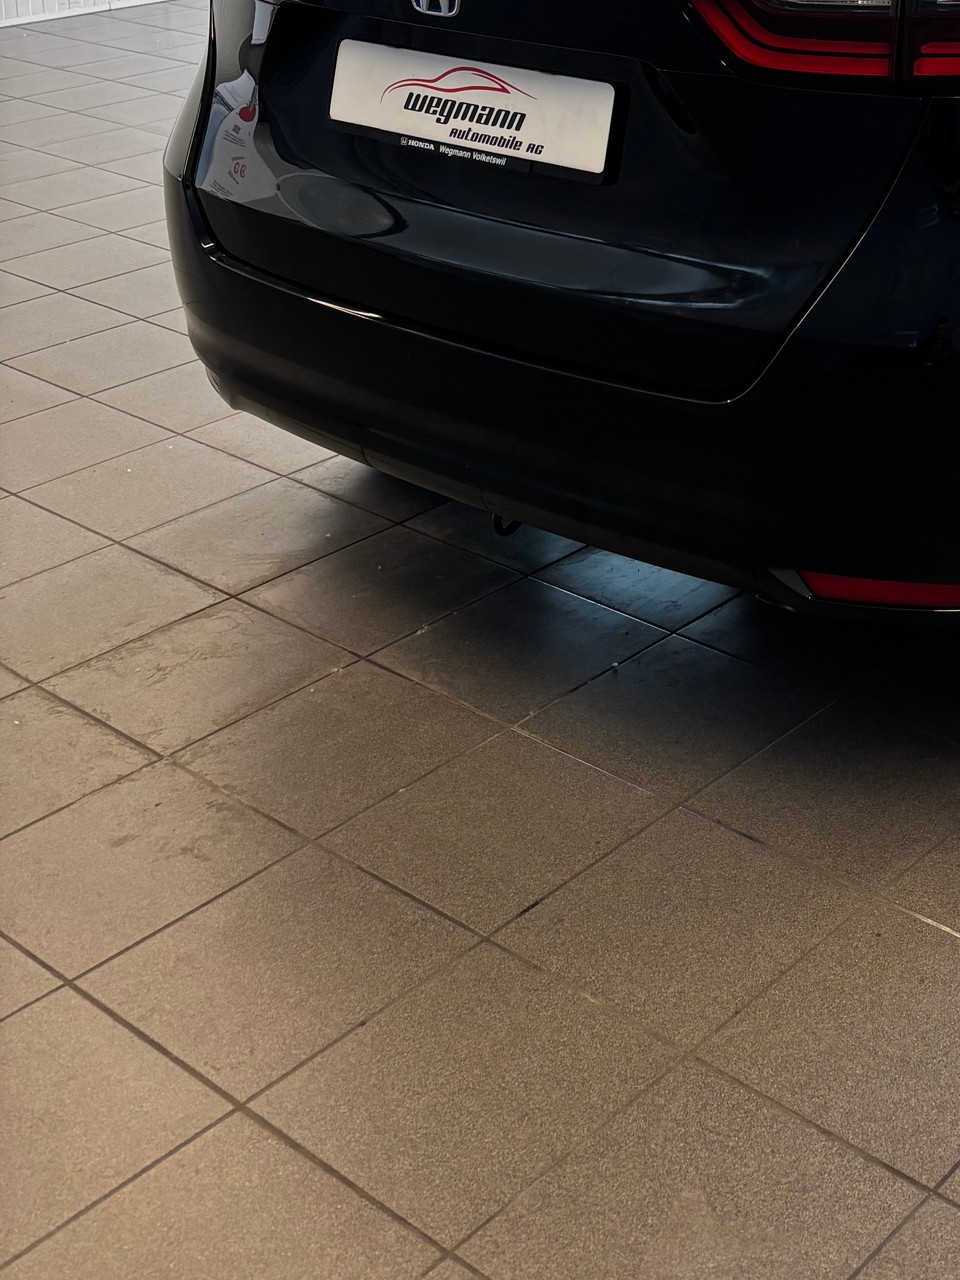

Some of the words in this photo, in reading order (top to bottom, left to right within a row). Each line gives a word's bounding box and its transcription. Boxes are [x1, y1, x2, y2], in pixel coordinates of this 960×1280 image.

[403, 91, 527, 132] wegmann
[408, 139, 435, 151] HONDA
[439, 144, 471, 159] Wegmann
[472, 151, 507, 166] Volketswil
[526, 143, 545, 155] AG
